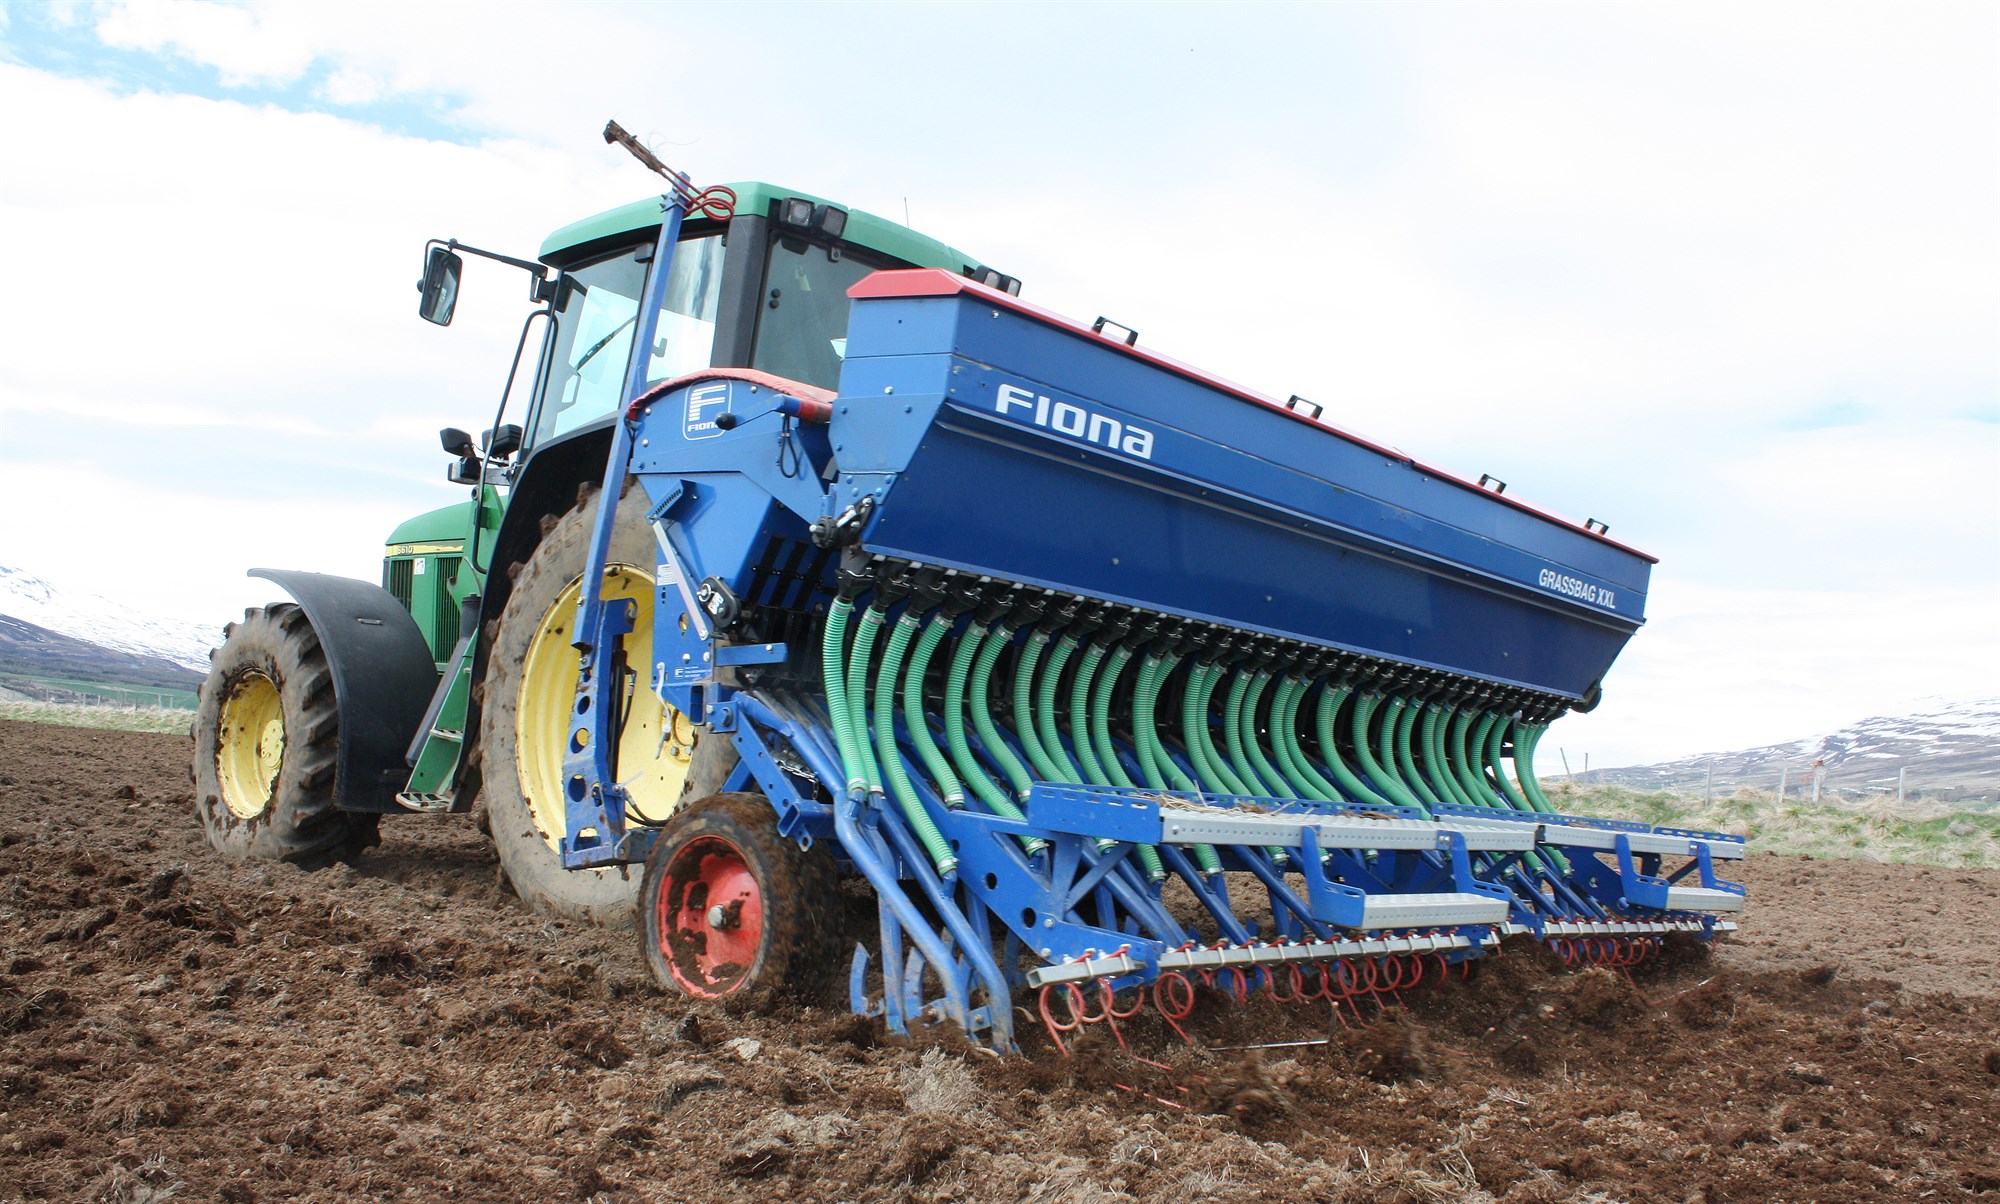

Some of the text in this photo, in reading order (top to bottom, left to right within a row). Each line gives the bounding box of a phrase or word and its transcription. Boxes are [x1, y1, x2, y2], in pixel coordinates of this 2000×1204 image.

[687, 421, 719, 433] Fion
[1538, 568, 1616, 609] GRASSBAG XXL
